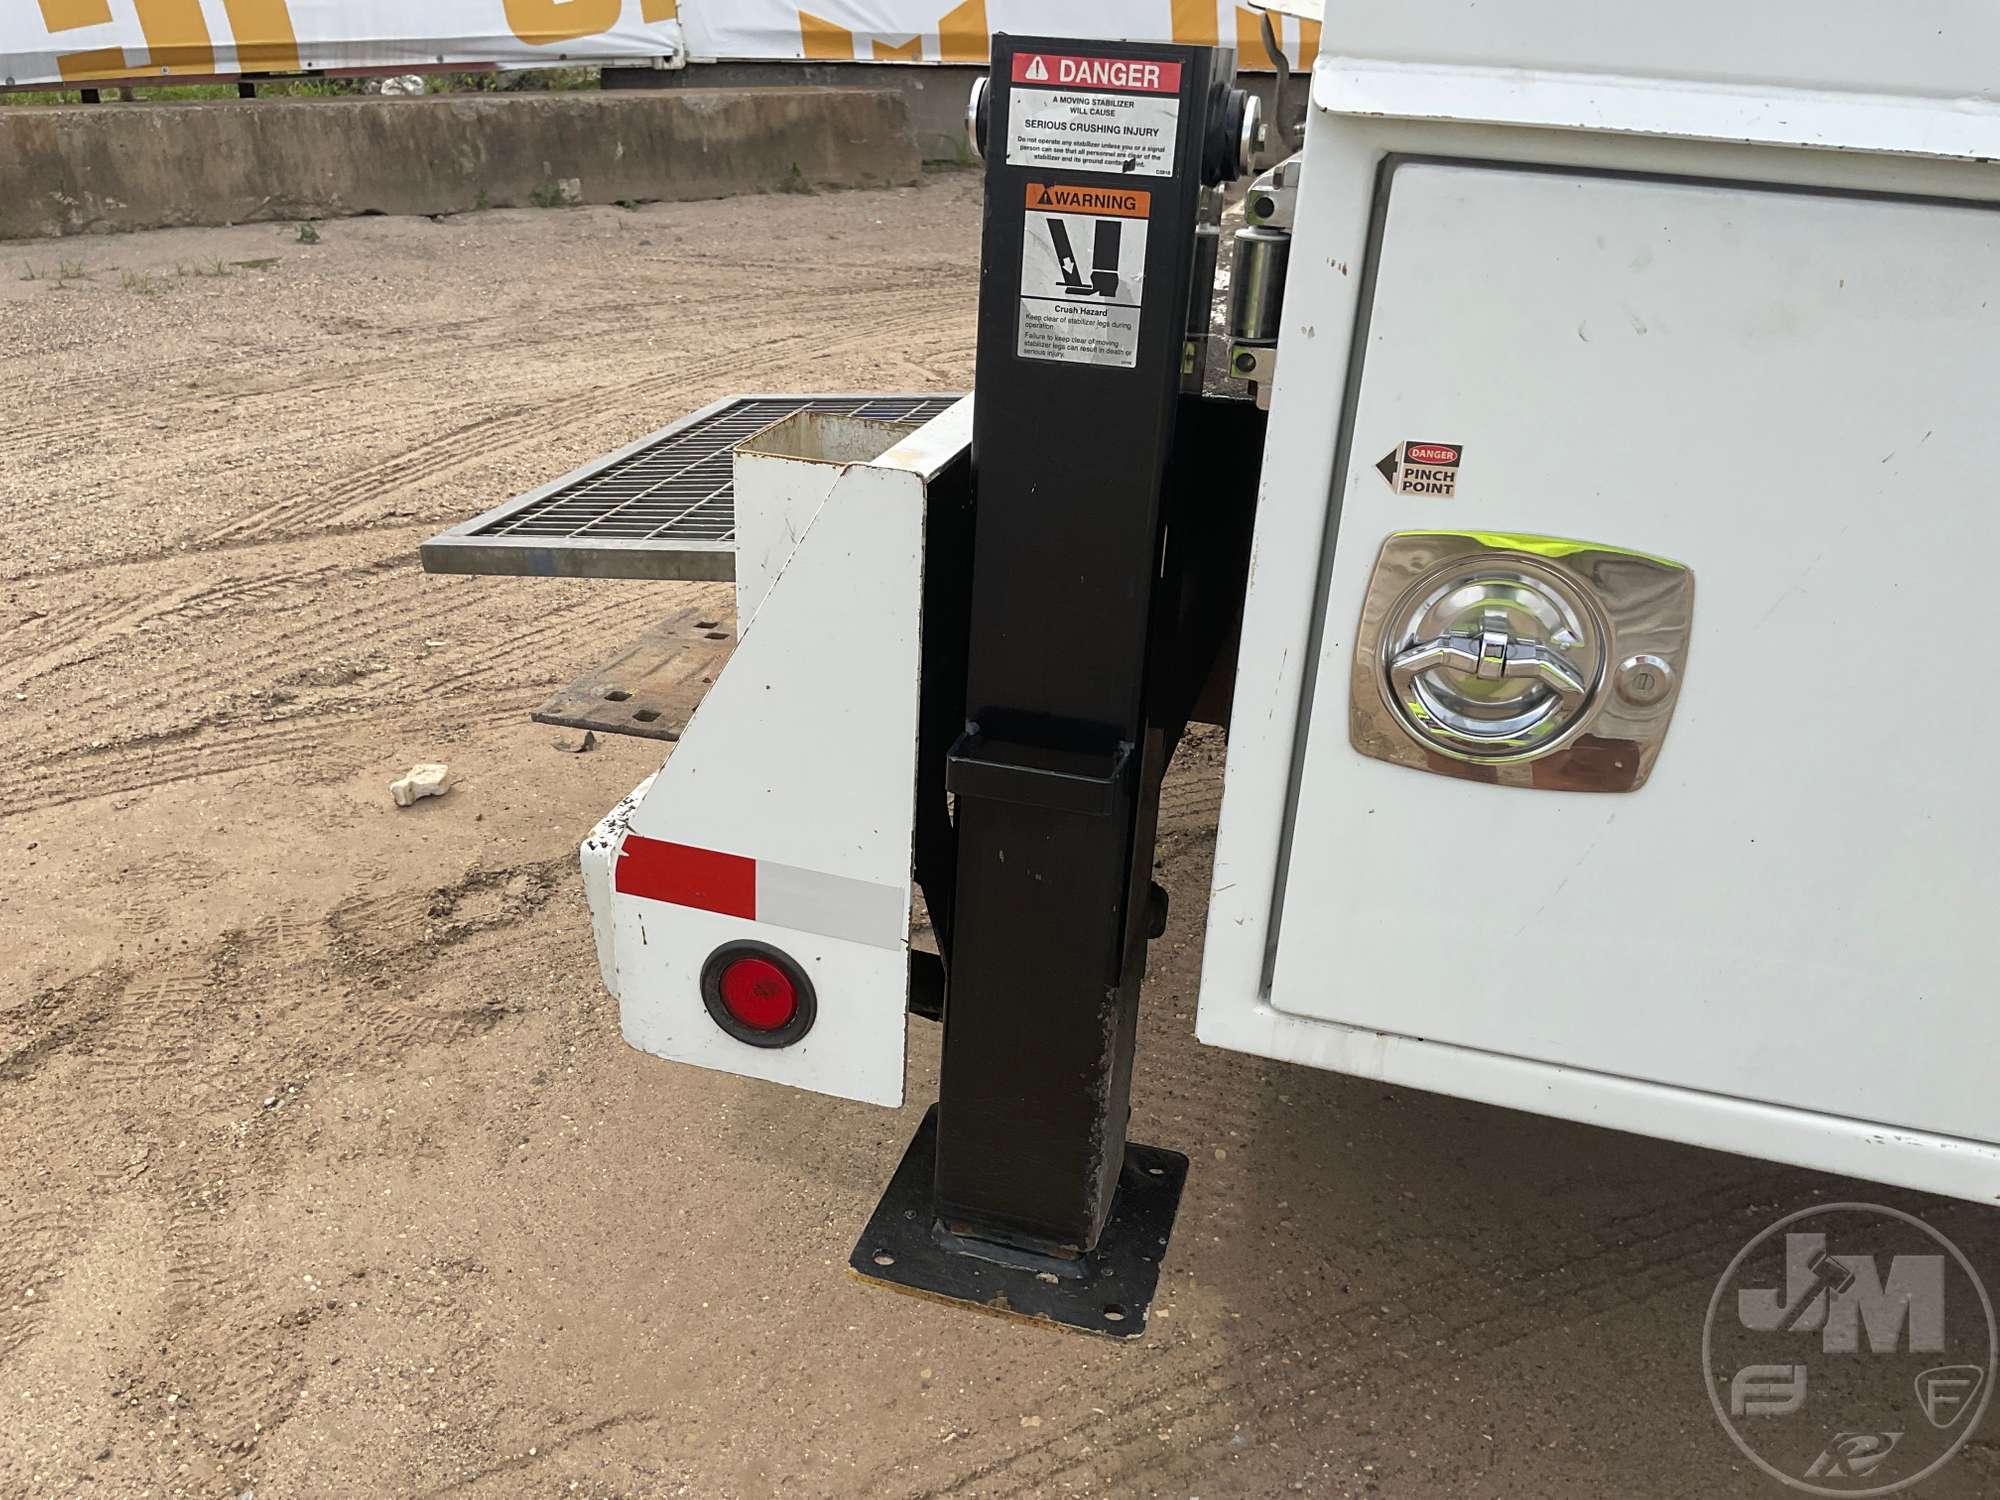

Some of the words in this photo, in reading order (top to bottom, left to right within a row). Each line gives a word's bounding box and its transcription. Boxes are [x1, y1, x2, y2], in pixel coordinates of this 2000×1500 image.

[1059, 59, 1160, 88] DANGER
[1060, 96, 1090, 105] MOVING
[1092, 99, 1135, 108] STABILIZER
[1070, 107, 1088, 115] WILL
[1090, 108, 1116, 117] CAUSE
[1025, 119, 1067, 131] SERIOUS
[1069, 122, 1121, 135] CRUSHING
[1123, 126, 1159, 137] INJURY
[1038, 138, 1060, 146] operate
[1073, 140, 1100, 148] stabilizer
[1147, 145, 1165, 153] signal
[1086, 150, 1115, 158] personnel
[1054, 191, 1136, 210] WARNING
[1025, 313, 1041, 321] Keep
[1055, 305, 1078, 314] Crush
[1080, 307, 1108, 316] Hazard
[1024, 331, 1046, 339] Failure
[1055, 334, 1071, 343] keep
[1072, 336, 1087, 344] clear
[1412, 449, 1453, 459] DANGER
[1404, 468, 1455, 482] PINCH
[1402, 480, 1454, 494] POINT
